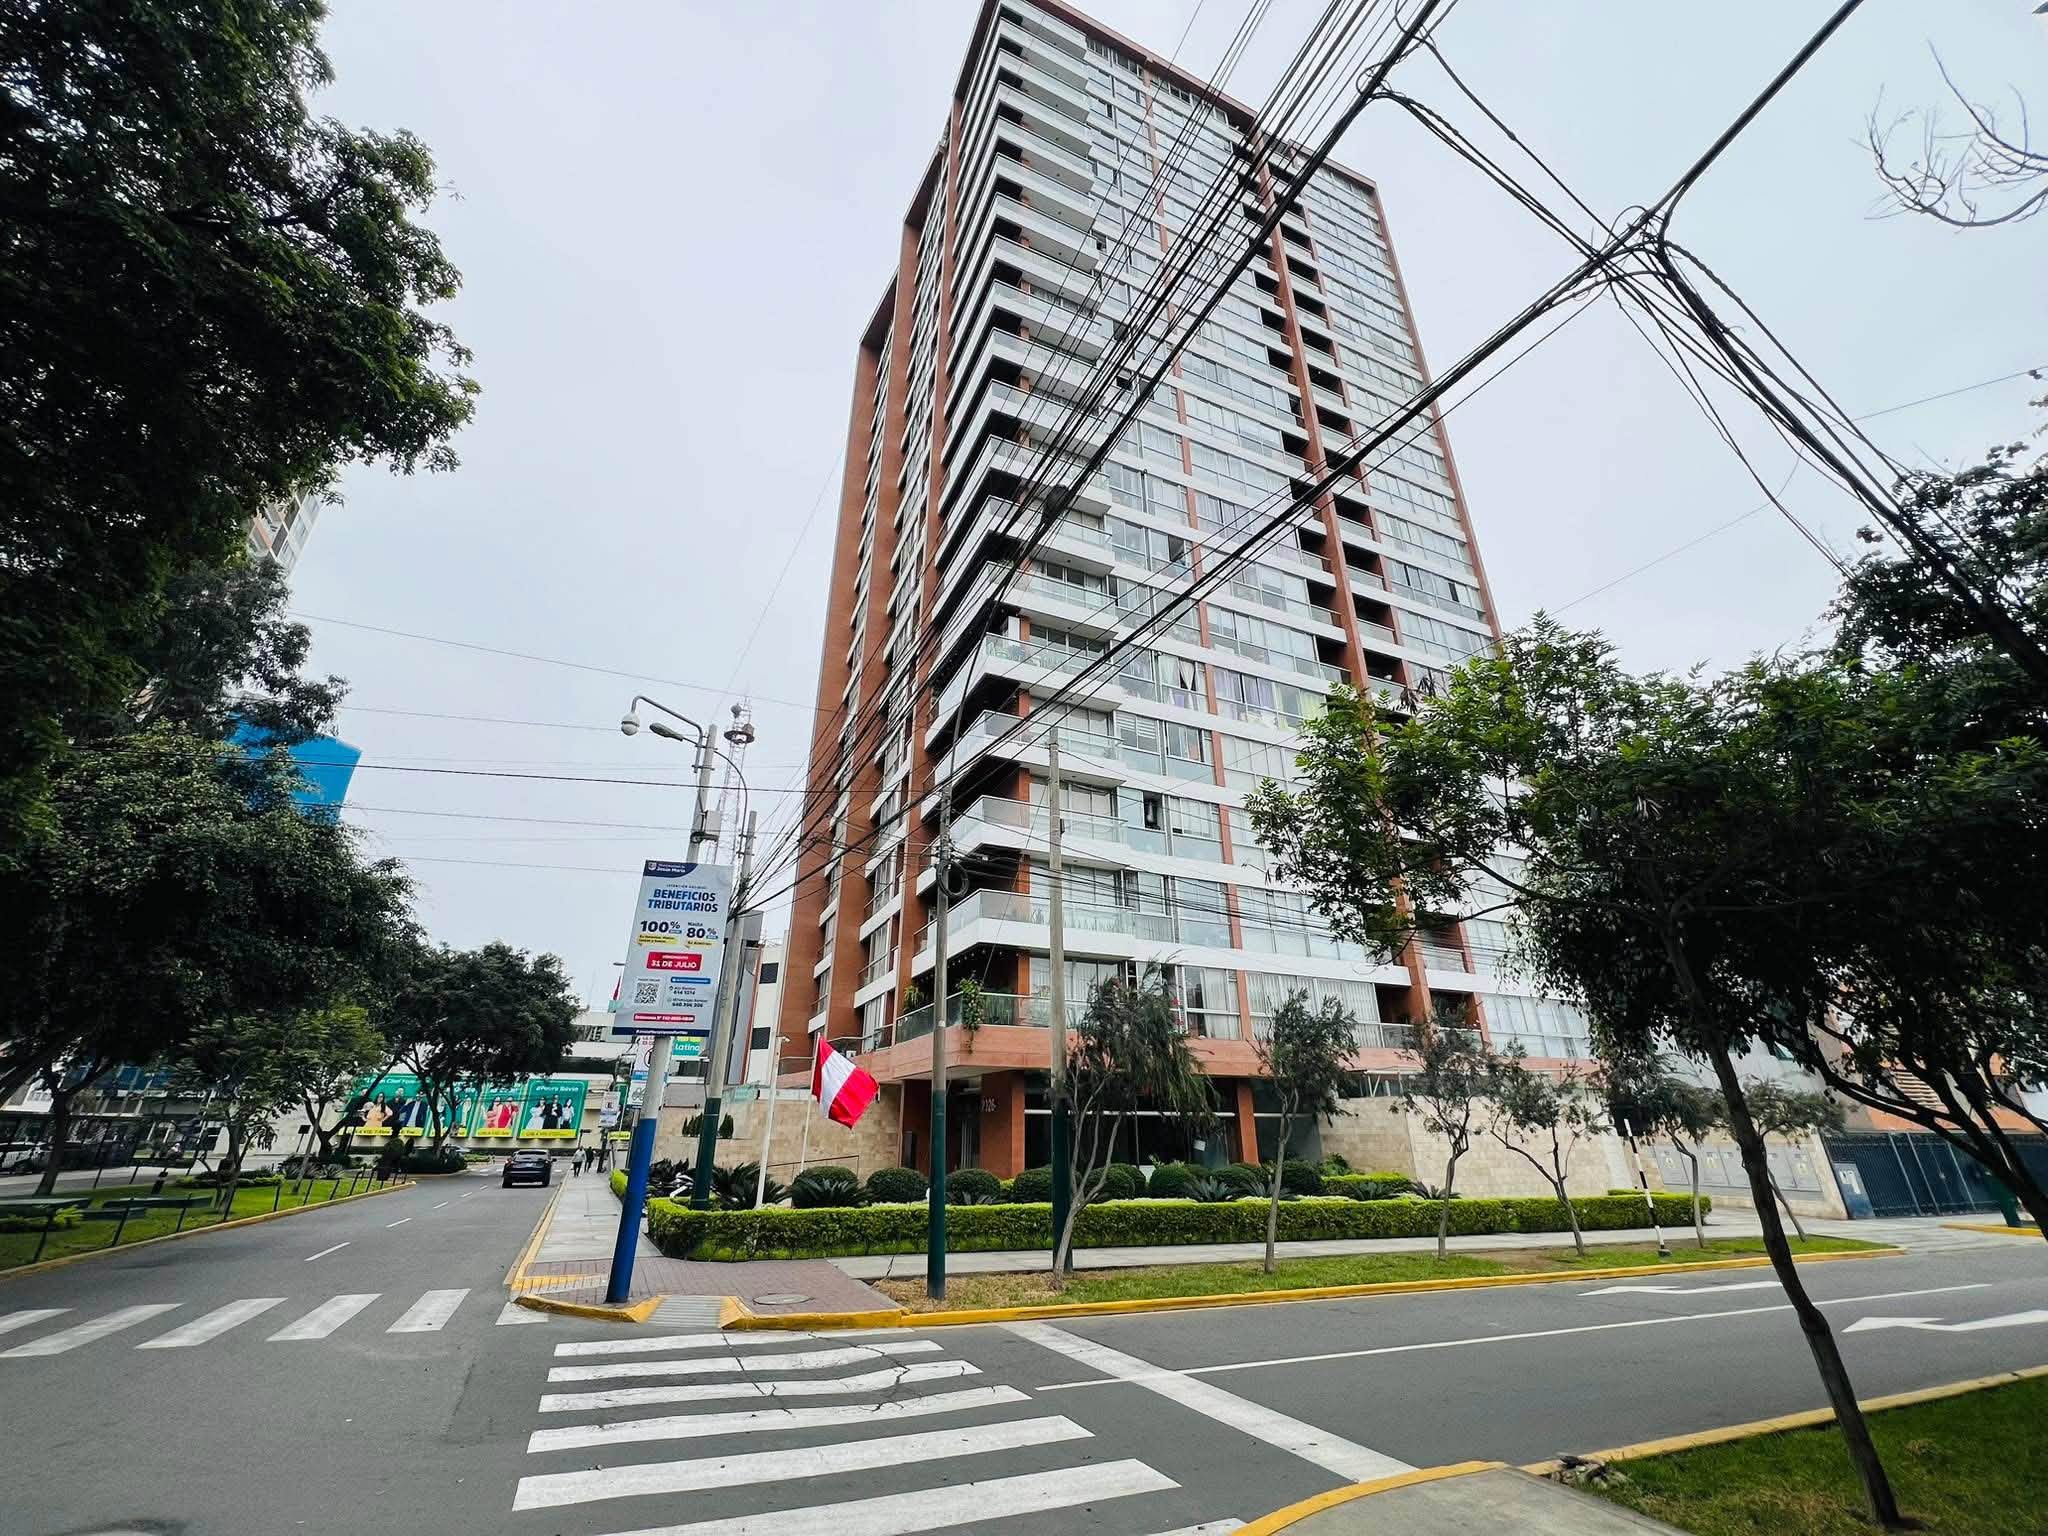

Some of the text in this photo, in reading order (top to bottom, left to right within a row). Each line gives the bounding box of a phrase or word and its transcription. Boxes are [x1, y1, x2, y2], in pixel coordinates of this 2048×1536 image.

[653, 888, 716, 902] BENEFICIOS
[647, 898, 719, 913] TRIBUTARIOS
[640, 920, 681, 933] 100%
[686, 927, 717, 939] 80%
[674, 961, 697, 969] JULIO
